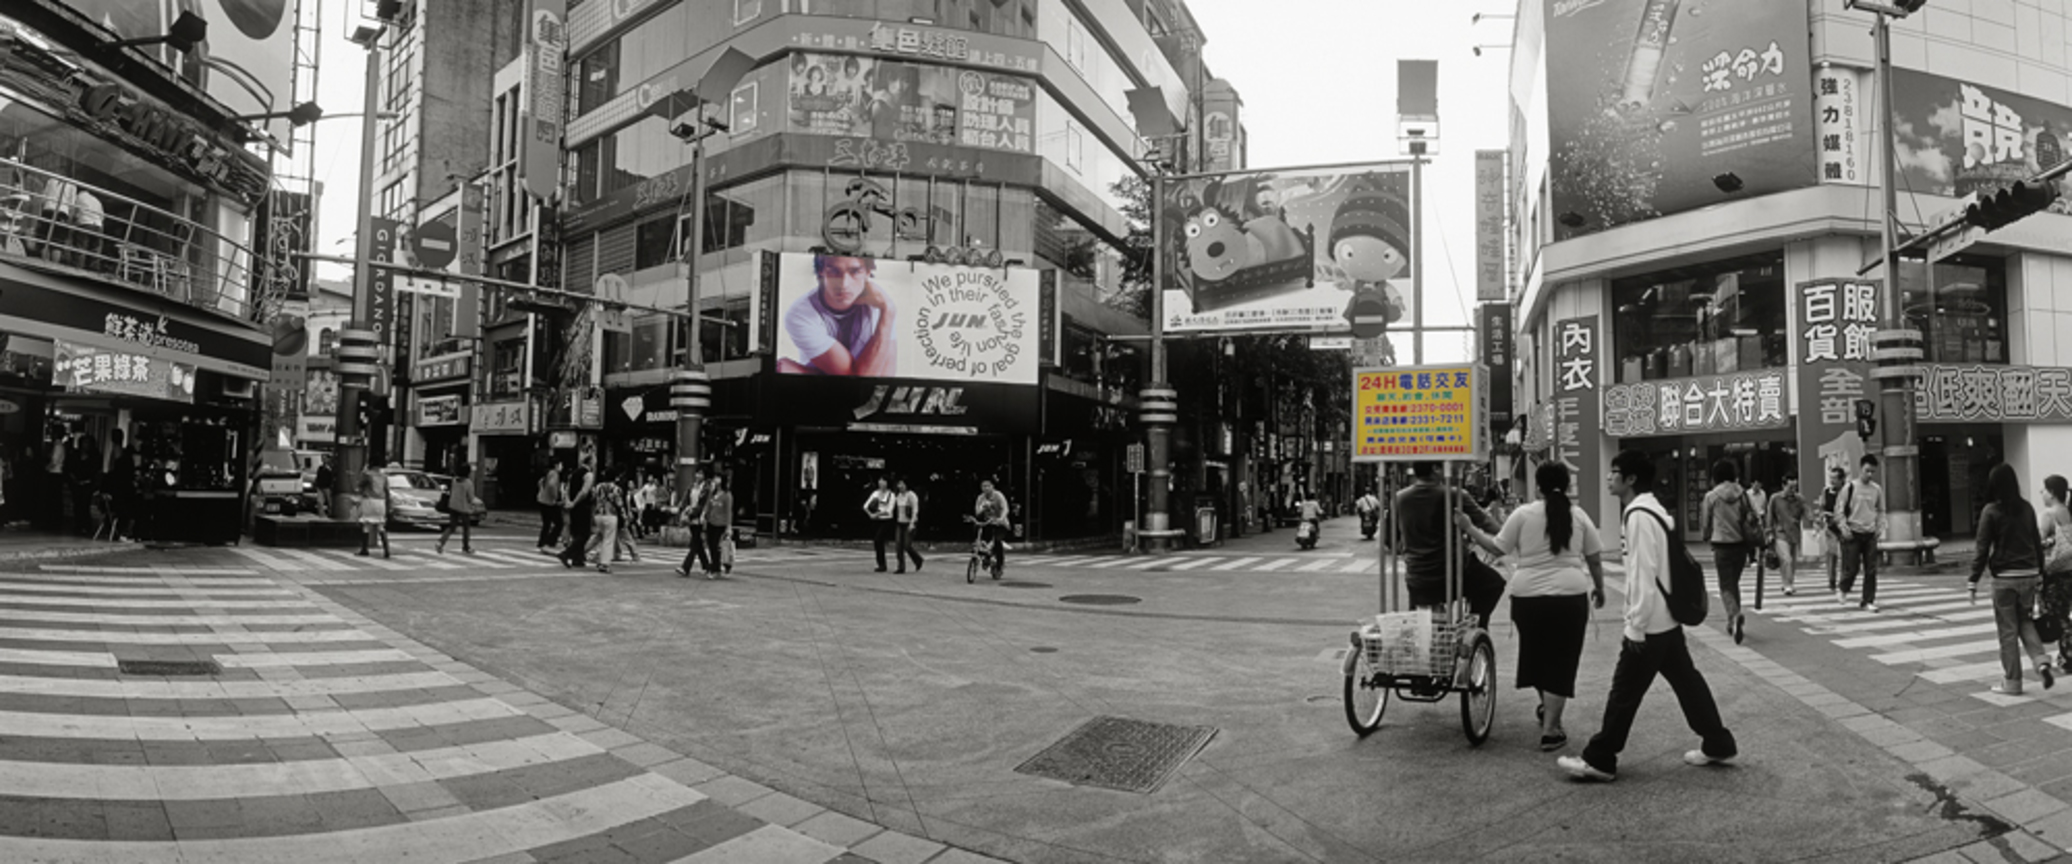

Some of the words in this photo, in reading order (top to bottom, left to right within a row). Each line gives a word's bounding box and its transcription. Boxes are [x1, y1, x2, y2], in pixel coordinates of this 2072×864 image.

[1702, 42, 1784, 92] 深命力
[1820, 78, 1843, 181] 強力媒體
[921, 274, 952, 295] We
[926, 293, 946, 308] in
[948, 287, 989, 303] their
[956, 272, 1020, 310] pursued
[104, 312, 155, 348] 鮮茶道
[913, 306, 967, 372] perfection
[931, 312, 988, 331] JUN
[976, 303, 1012, 353] fashion
[1011, 312, 1027, 340] the
[1803, 283, 1839, 364] 百貨
[1842, 283, 1878, 362] 服飾
[949, 331, 971, 357] life
[992, 342, 1021, 377] goal
[1562, 322, 1594, 391] 內衣
[72, 353, 150, 387] 芒果綠茶
[970, 361, 987, 378] of
[853, 384, 966, 421] JUN
[1660, 376, 1783, 428] 聯合大特賣
